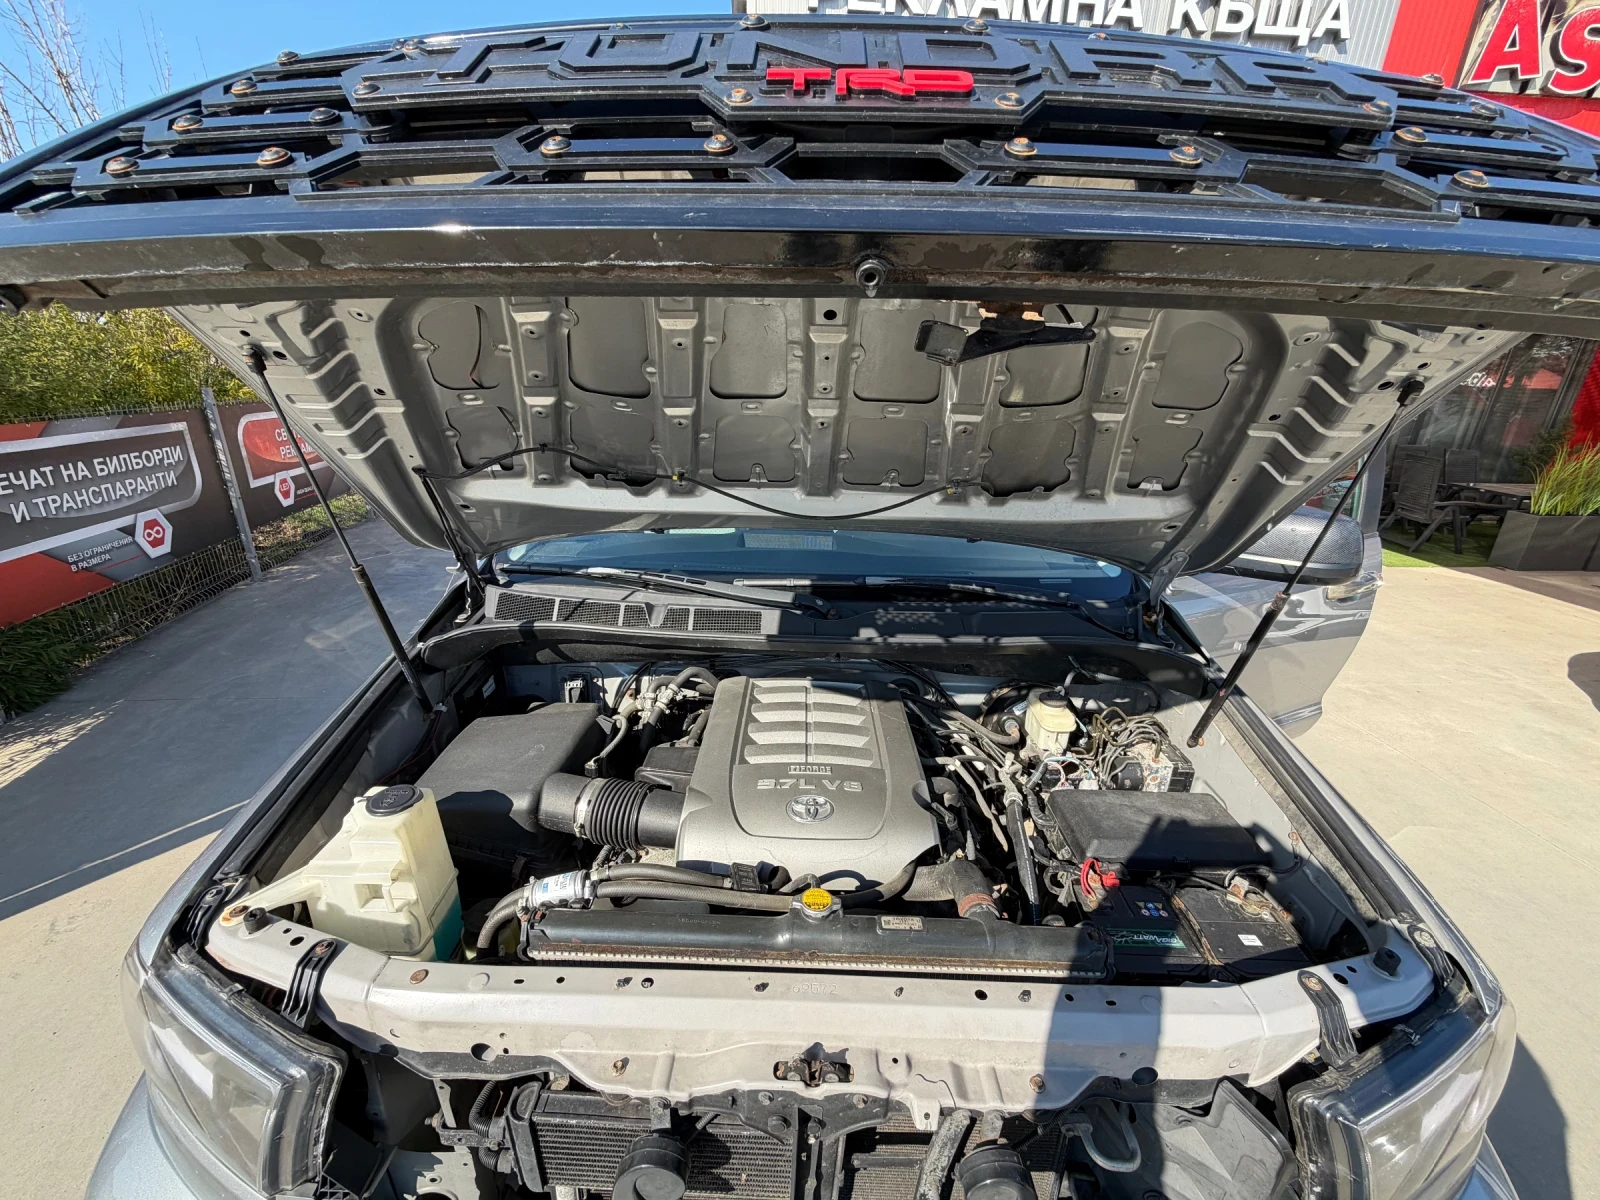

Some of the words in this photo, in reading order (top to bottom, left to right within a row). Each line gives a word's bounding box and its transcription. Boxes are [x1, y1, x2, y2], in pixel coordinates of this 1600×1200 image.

[766, 67, 974, 96] TRD
[60, 461, 92, 483] НА
[93, 445, 183, 476] БИЛБОРДИ
[9, 501, 31, 524] И
[32, 470, 178, 517] ТРАНСПАРАНТИ
[67, 552, 84, 563] БЕЗ
[84, 535, 134, 558] ОГРАНИЧЕНИЯ
[78, 553, 111, 570] РАЗМЕРА
[757, 778, 816, 790] 5.7L
[821, 779, 864, 792] V8
